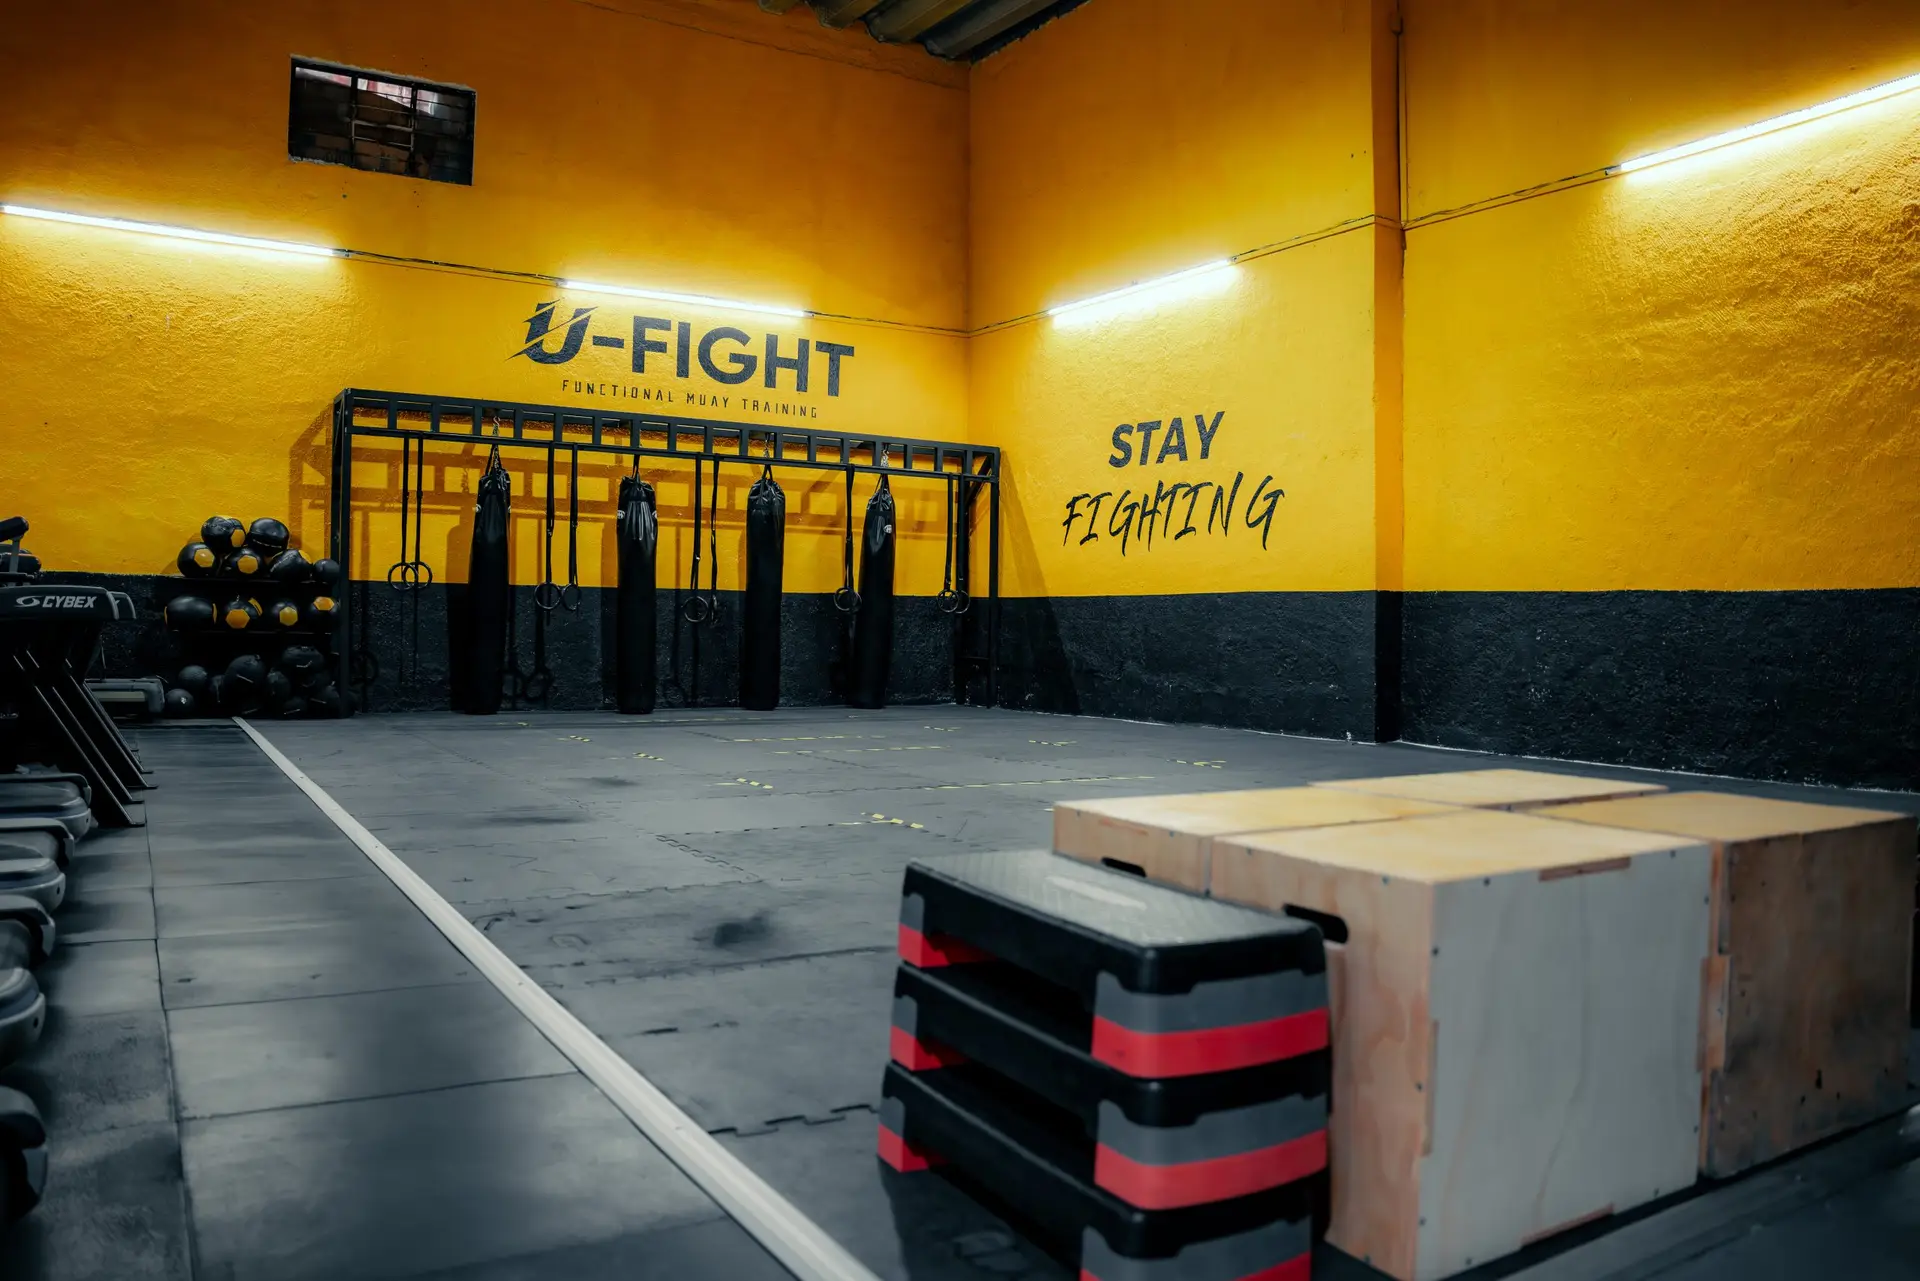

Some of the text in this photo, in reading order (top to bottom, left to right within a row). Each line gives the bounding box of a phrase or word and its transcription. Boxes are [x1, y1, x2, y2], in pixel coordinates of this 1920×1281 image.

[504, 299, 855, 397] U-FIGHT
[562, 379, 818, 418] FUNCTIONAL MUAY TRAINING
[1108, 410, 1225, 468] STAY
[1062, 471, 1285, 557] FIGHTING
[42, 595, 97, 608] CYBEX
